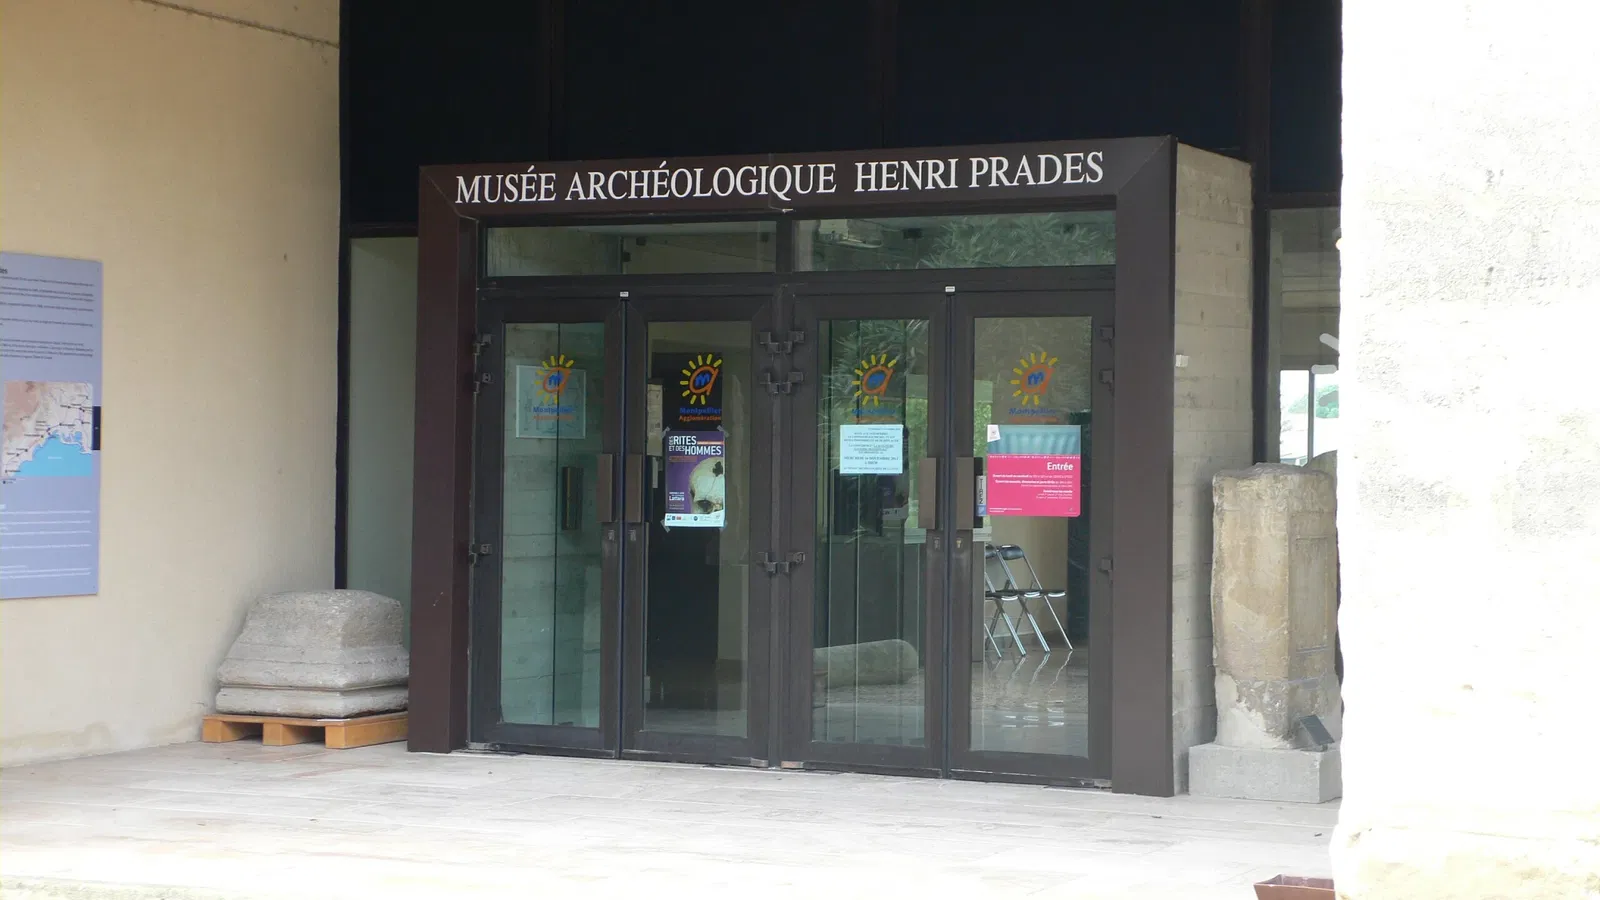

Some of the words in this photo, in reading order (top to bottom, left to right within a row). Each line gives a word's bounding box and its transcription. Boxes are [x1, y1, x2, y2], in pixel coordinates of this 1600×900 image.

[455, 164, 557, 204] MUSÉE
[564, 160, 837, 201] ARCHÉOLOGIQUE
[853, 158, 959, 193] HENRI
[968, 151, 1104, 188] PRADES
[673, 435, 697, 446] RITES
[684, 445, 722, 456] HOMMES
[1047, 462, 1074, 471] Entrée
